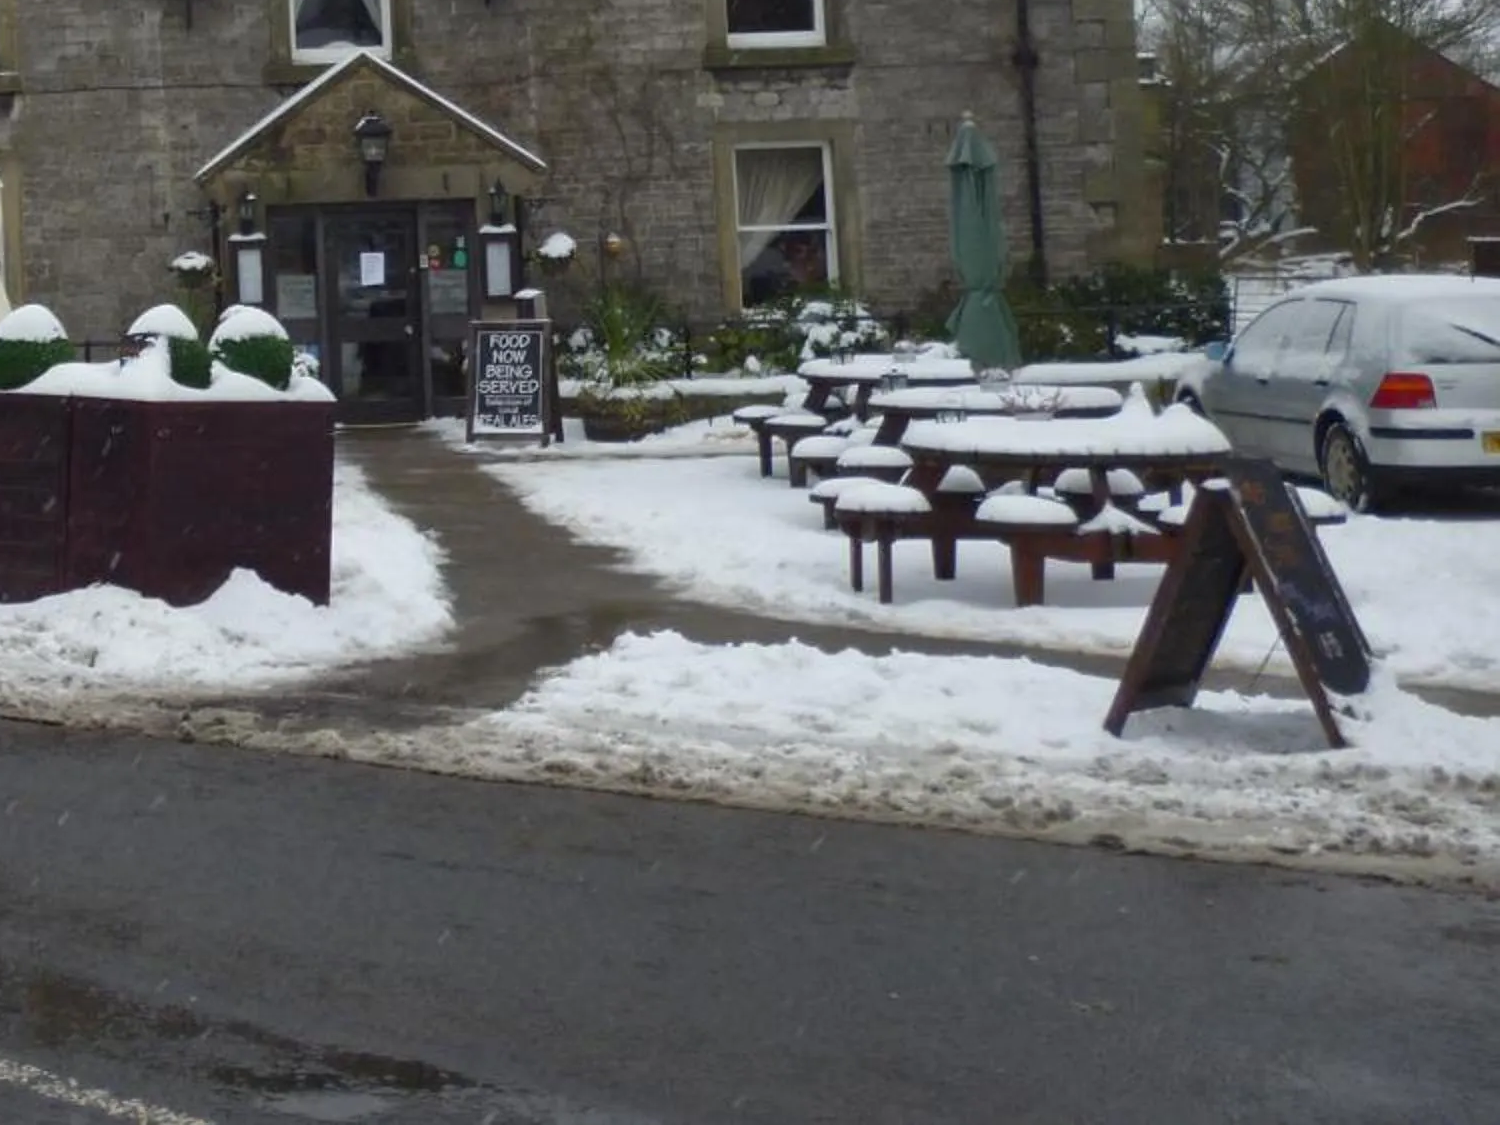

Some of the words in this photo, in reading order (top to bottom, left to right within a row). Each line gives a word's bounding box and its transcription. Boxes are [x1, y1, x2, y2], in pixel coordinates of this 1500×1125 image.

[489, 334, 531, 348] FOOD
[492, 350, 527, 364] NOW
[485, 364, 533, 378] BEING
[479, 379, 539, 394] SERVED
